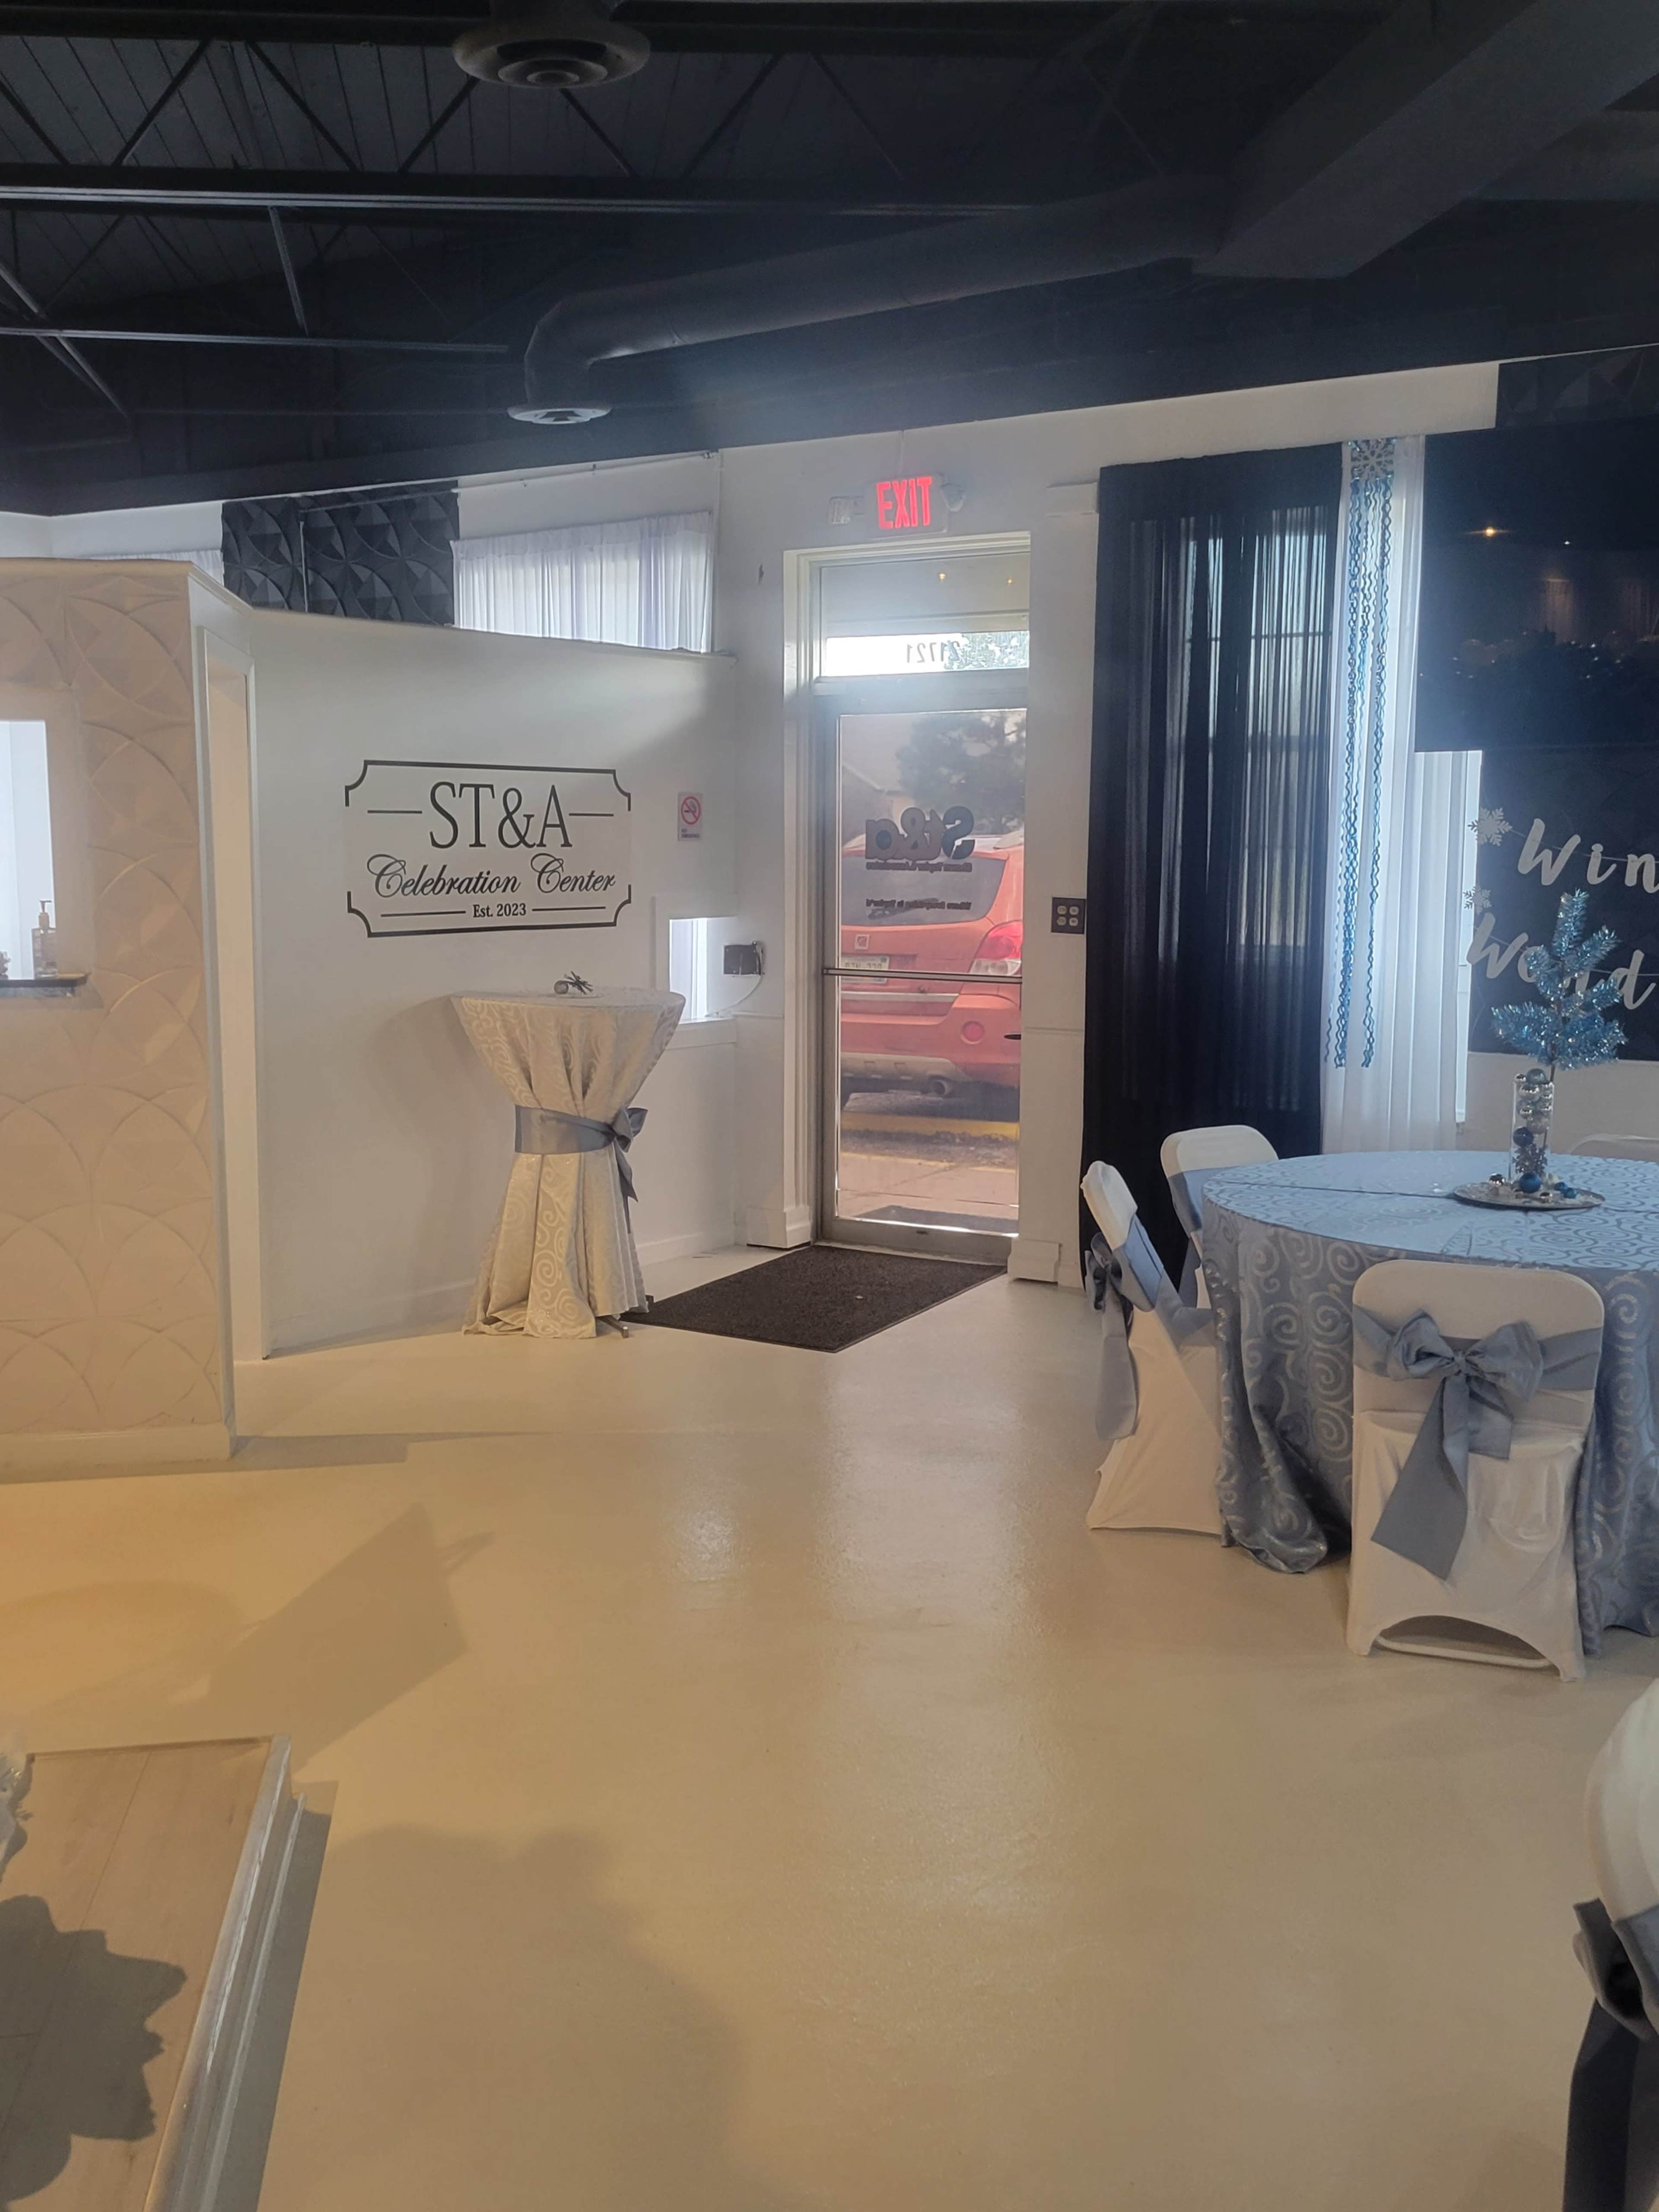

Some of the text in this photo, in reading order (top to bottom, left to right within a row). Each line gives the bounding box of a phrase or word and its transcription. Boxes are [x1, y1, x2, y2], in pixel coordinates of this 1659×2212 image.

[876, 476, 932, 528] EXIT
[429, 781, 572, 849] ST&A
[367, 852, 616, 897] Celebration Center
[1517, 818, 1659, 893] Win
[473, 903, 526, 918] Est. 2023
